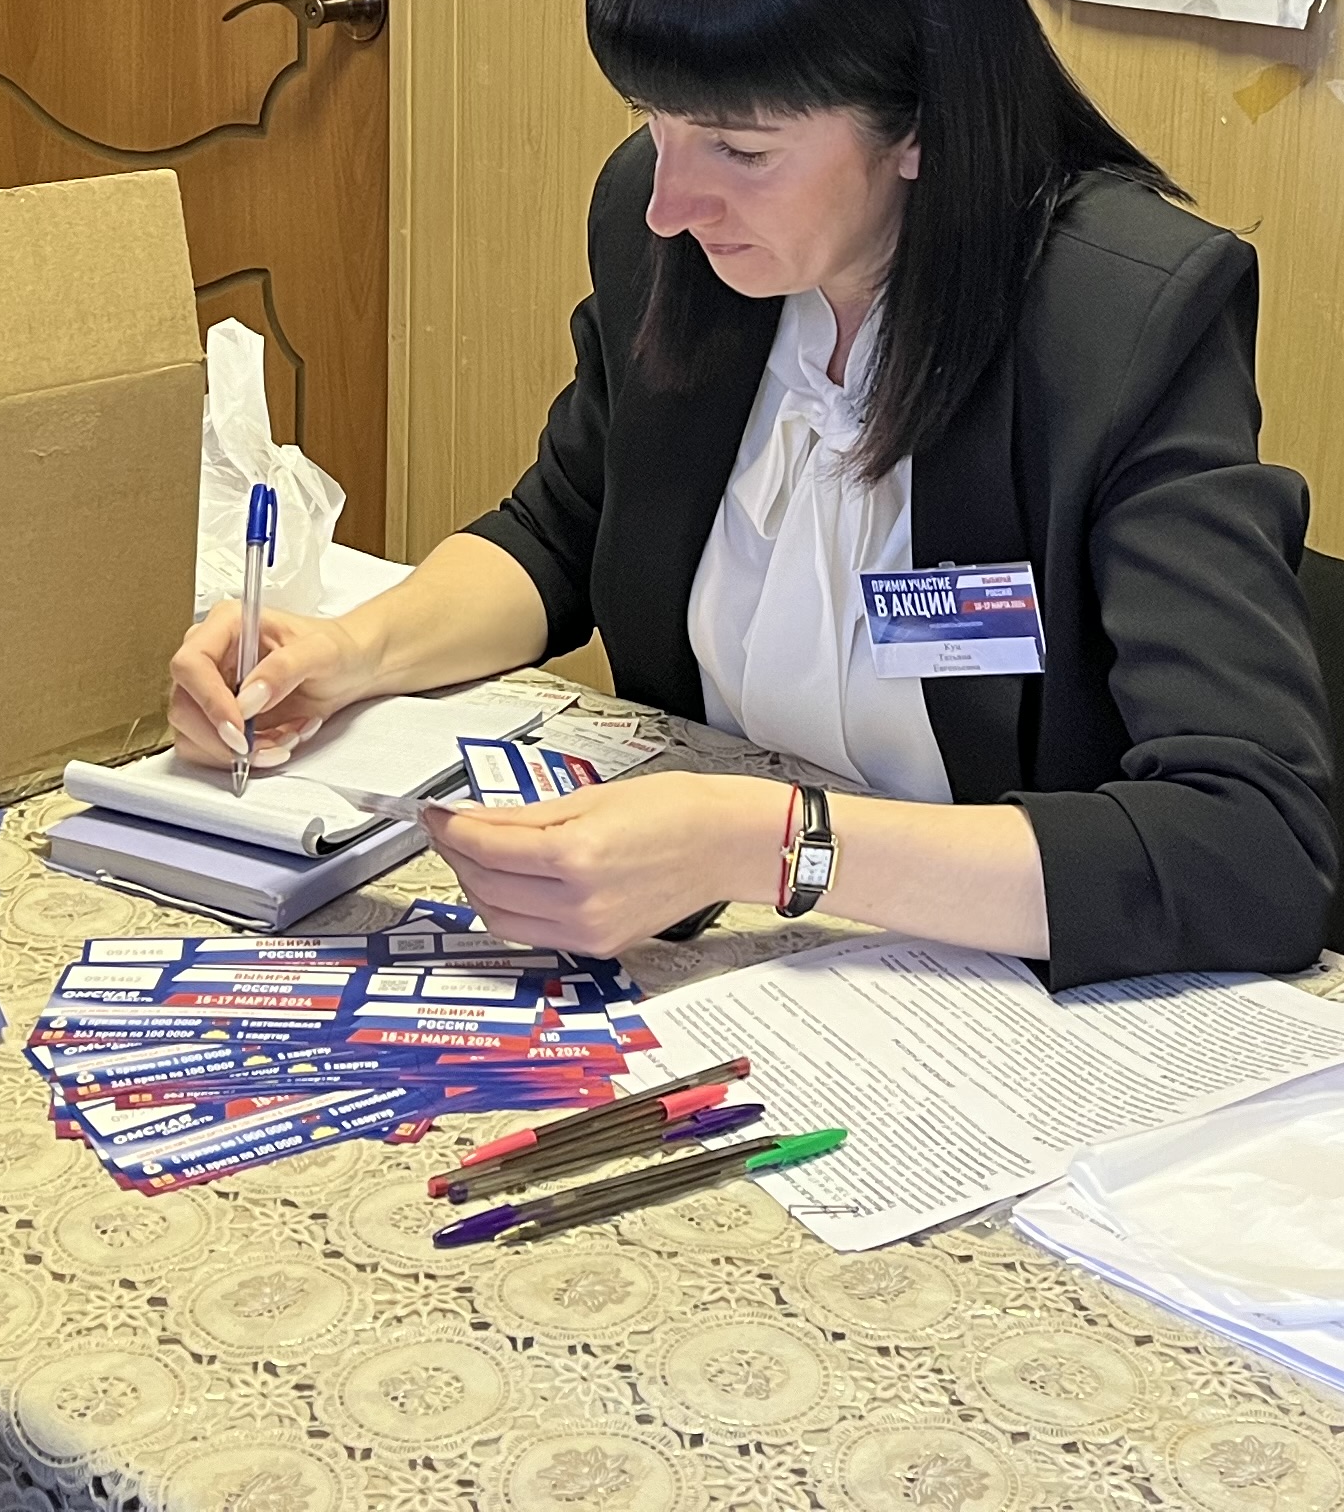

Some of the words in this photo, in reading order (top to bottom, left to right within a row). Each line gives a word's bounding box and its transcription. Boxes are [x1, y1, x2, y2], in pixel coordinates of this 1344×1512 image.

[871, 579, 907, 593] ПРИМИ
[908, 576, 952, 591] УЧАСТИЕ
[874, 595, 888, 617] В
[892, 591, 957, 618] АКЦИИ
[258, 951, 317, 959] РОССИЮ
[232, 984, 292, 993] РОССИЮ
[238, 996, 277, 1006] МАРТА
[280, 997, 312, 1007] 2024
[416, 1019, 479, 1031] РОССИЮ
[420, 1034, 465, 1045] МАРТА
[467, 1035, 501, 1047] 2024
[563, 1046, 590, 1057] 2024
